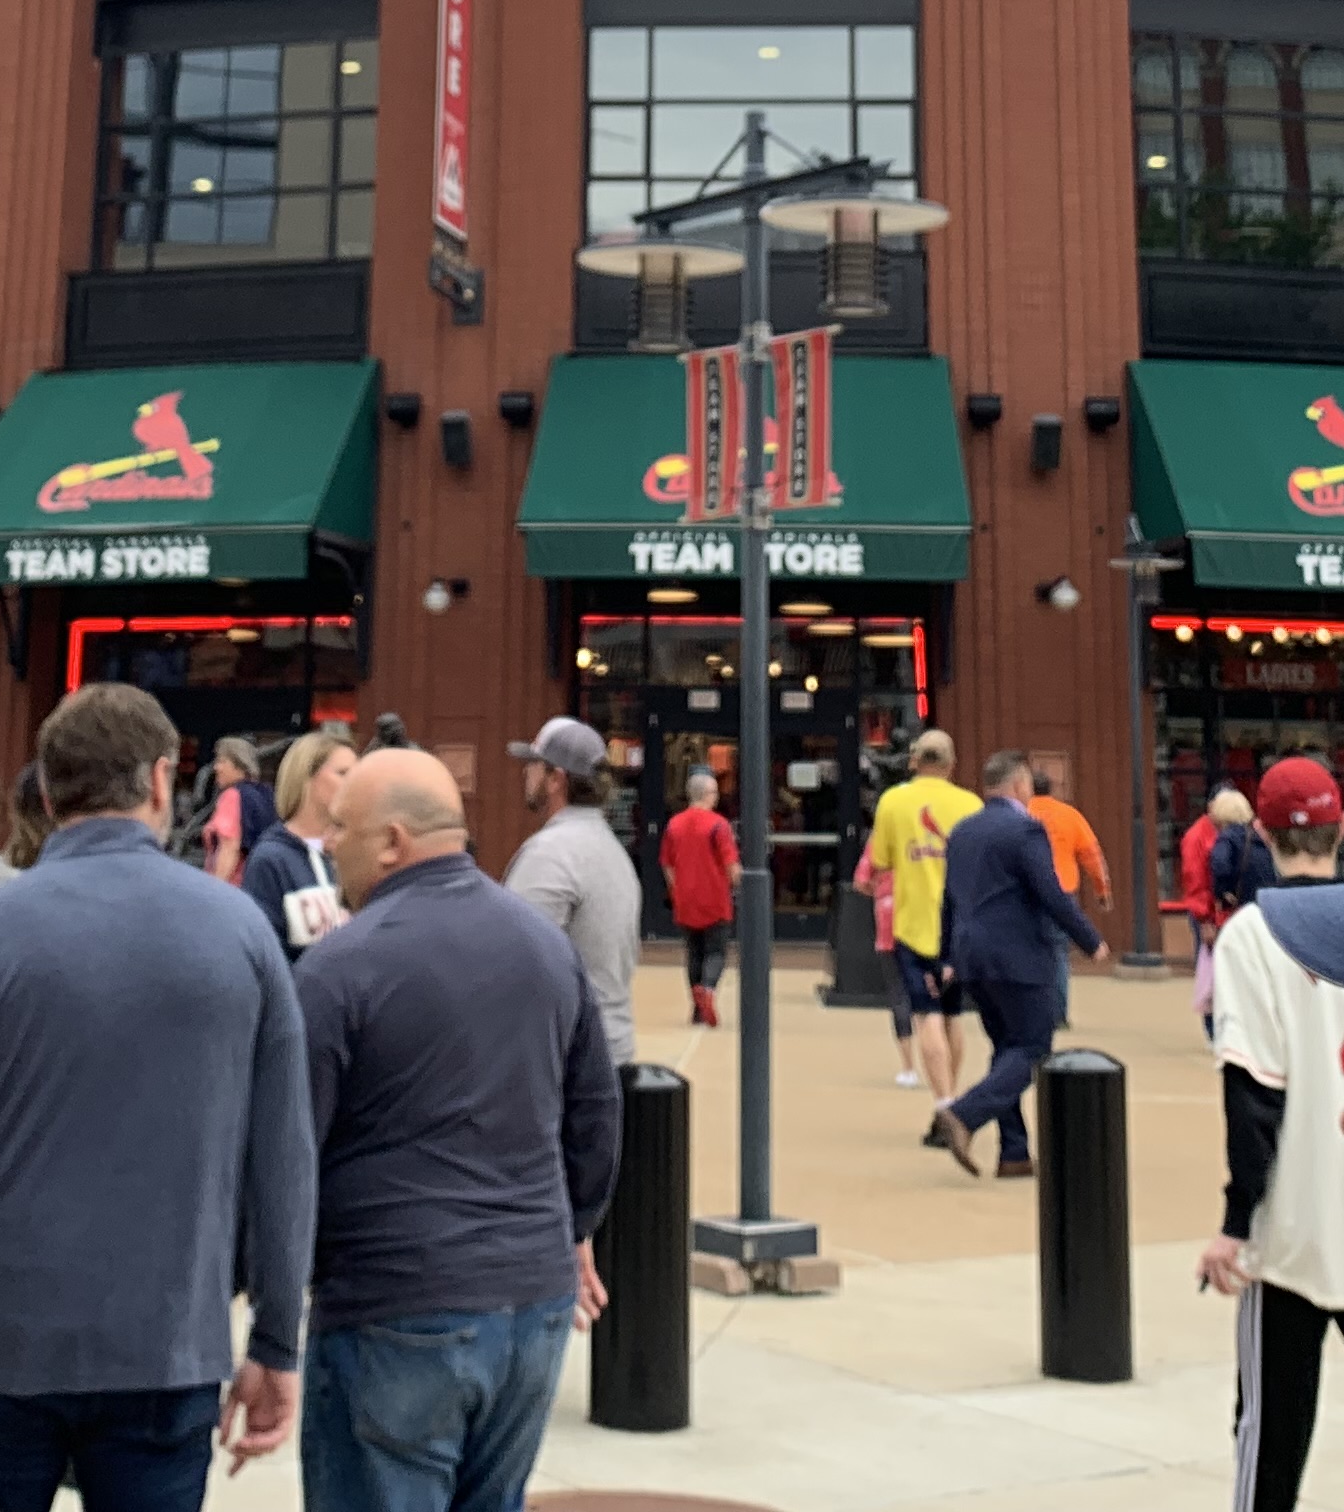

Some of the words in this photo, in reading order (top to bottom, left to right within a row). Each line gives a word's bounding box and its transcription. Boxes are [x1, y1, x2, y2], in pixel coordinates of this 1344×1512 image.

[5, 548, 96, 580] TEAM
[101, 544, 211, 579] STORE
[629, 542, 735, 574] TEAM
[763, 543, 865, 575] TORE
